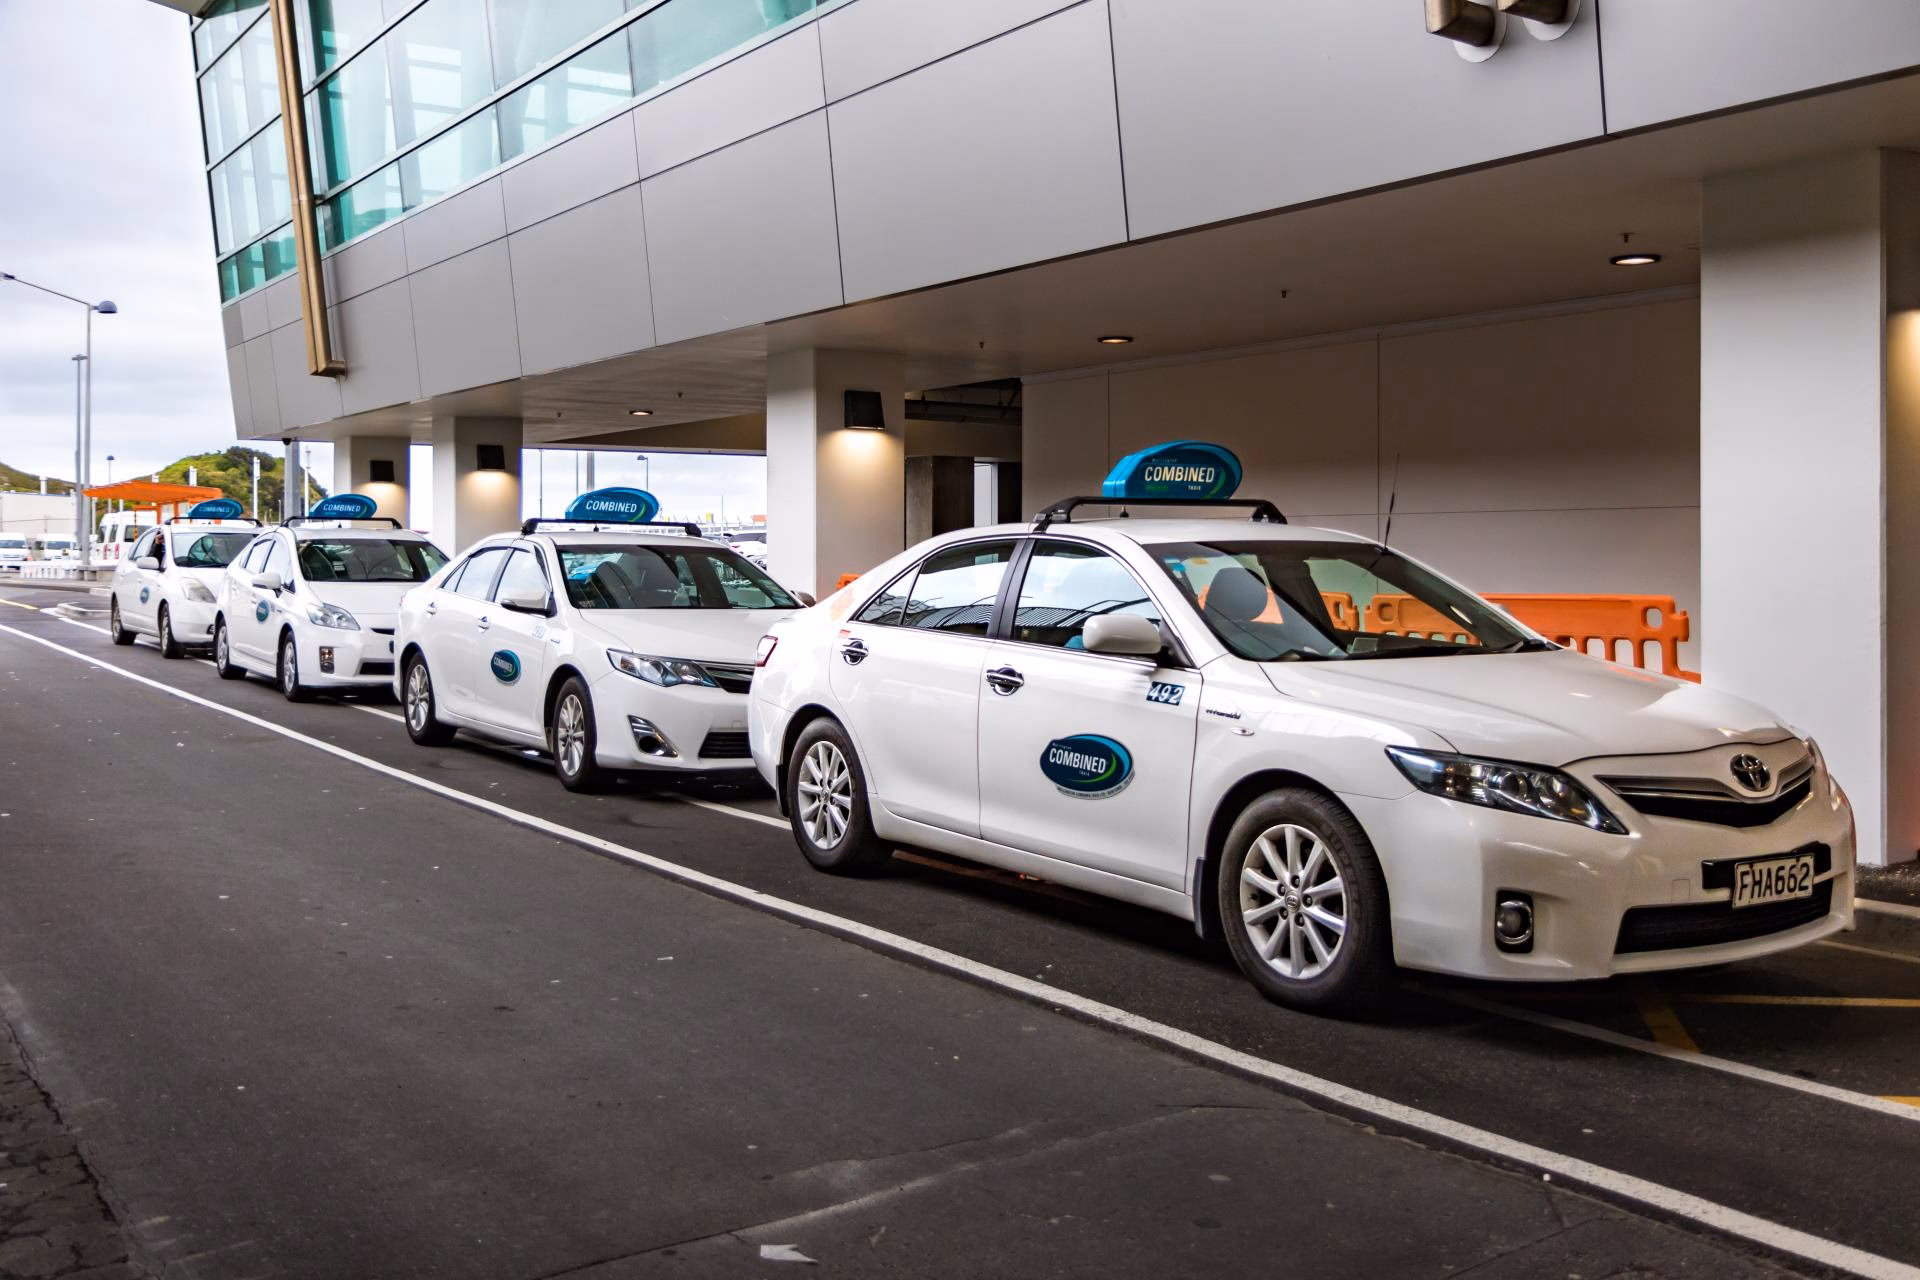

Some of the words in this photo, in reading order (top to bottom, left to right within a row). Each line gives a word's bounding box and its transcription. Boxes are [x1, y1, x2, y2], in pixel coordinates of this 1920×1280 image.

[1144, 466, 1215, 483] COMBINED
[323, 503, 361, 512] COMBINED
[585, 500, 637, 513] COMBINED
[1148, 684, 1183, 704] 492
[1049, 748, 1106, 774] COMBINED
[1739, 862, 1810, 901] FHA662
